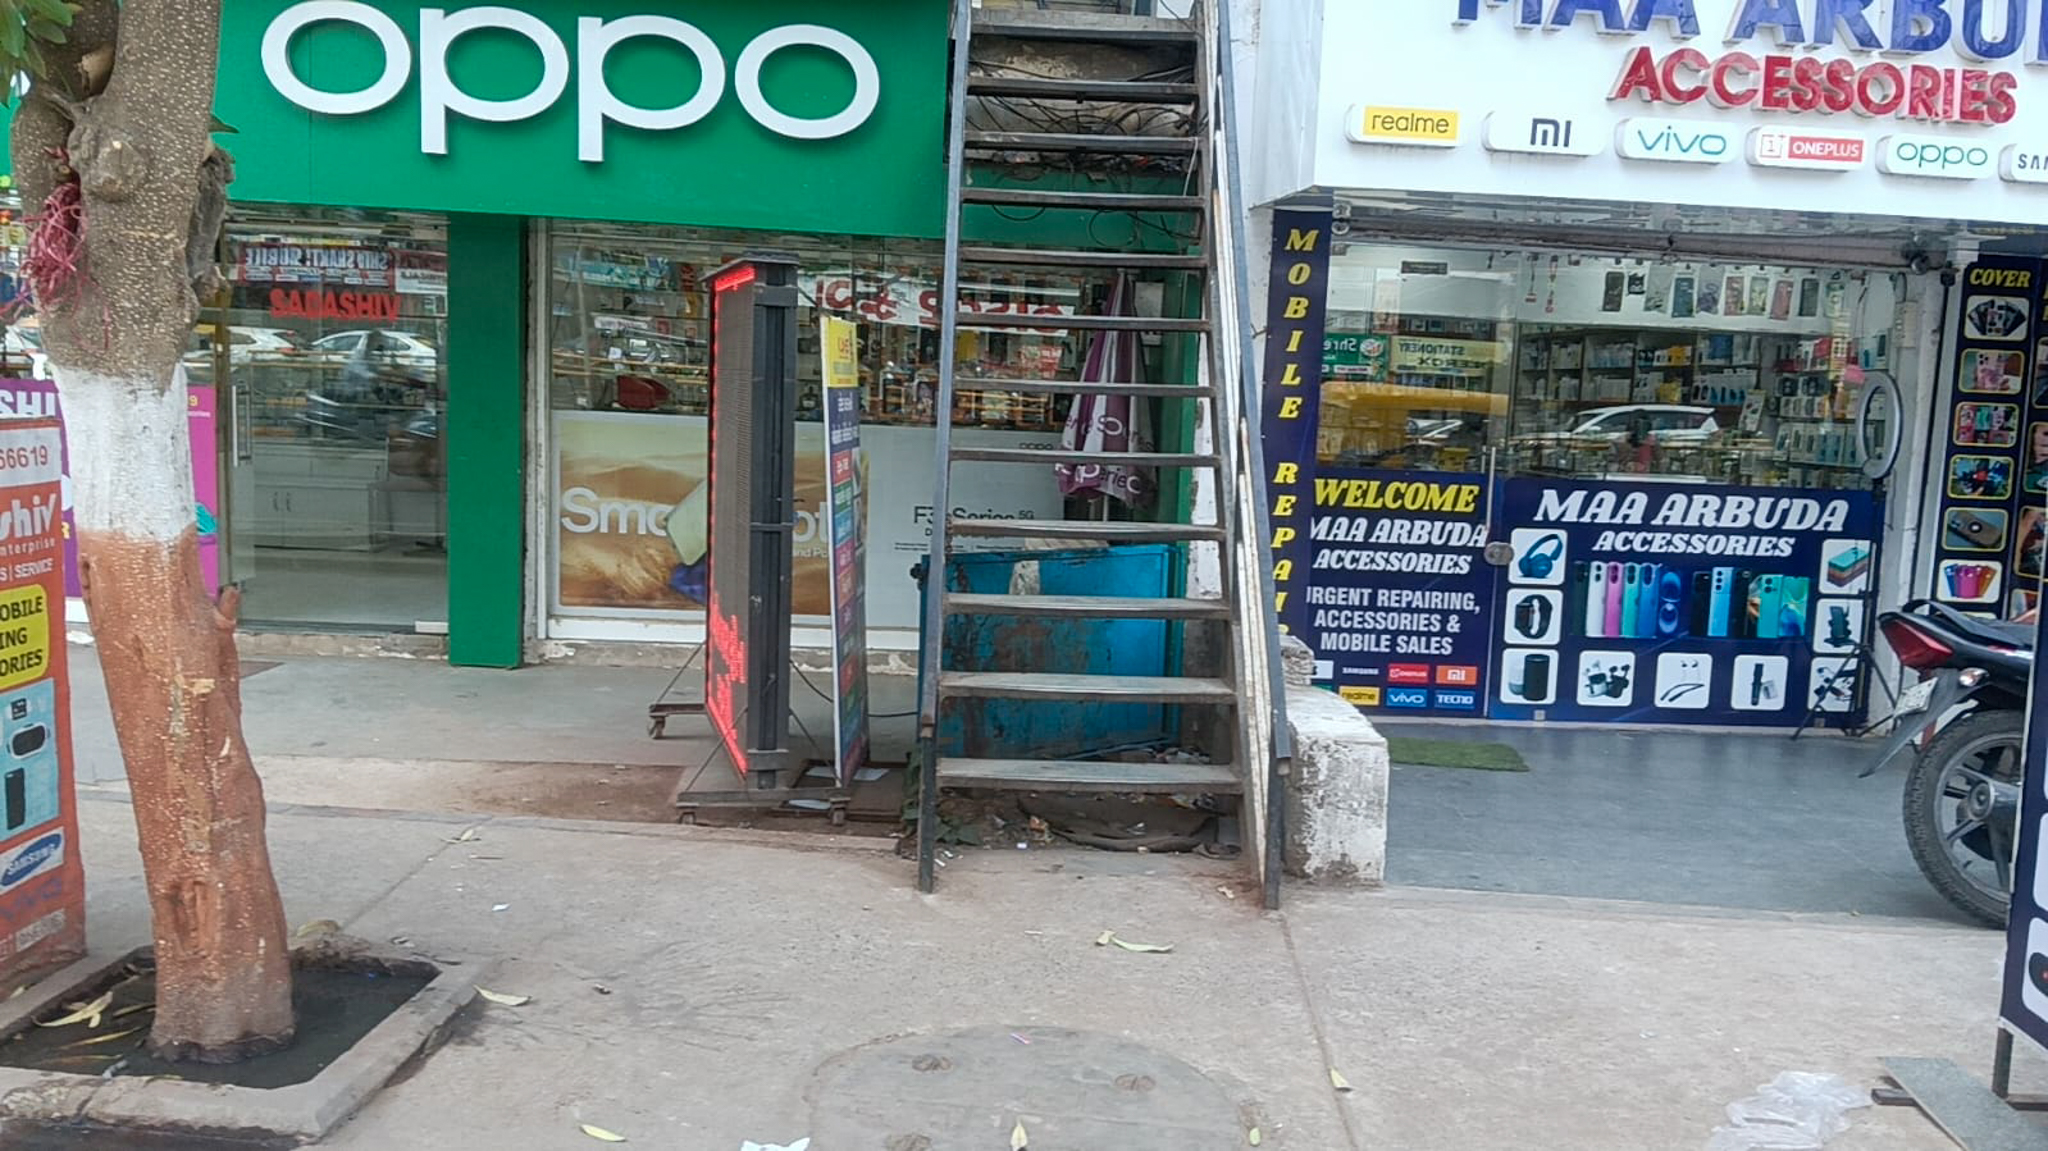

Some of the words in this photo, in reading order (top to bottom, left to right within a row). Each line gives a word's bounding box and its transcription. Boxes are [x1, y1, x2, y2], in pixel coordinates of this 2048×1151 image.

[1723, 0, 2048, 64] ARBU
[261, 0, 880, 162] oppo
[1612, 46, 2018, 124] ACCESSORIES
[1371, 112, 1450, 135] realme
[1637, 125, 1727, 156] vivo
[1792, 141, 1861, 157] ONEPLUS
[1896, 142, 1989, 169] oppo
[1969, 268, 2031, 287] COVER
[270, 287, 400, 322] SADASHIV
[1277, 229, 1319, 419] MOBILE
[1313, 478, 1480, 512] WELCOME
[1533, 488, 1651, 525] MAA
[1651, 494, 1849, 532] ARBUDA
[1369, 518, 1488, 548] ARBUDA
[1591, 531, 1796, 558] ACCESSORIES
[14, 557, 54, 578] SERVICE
[1313, 549, 1472, 574] ACCESSORIES
[1377, 588, 1480, 614] REPAIRING,
[1314, 610, 1441, 632] ACCESSORIES
[1446, 614, 1461, 633] &
[1320, 632, 1391, 653] MOBILE
[1396, 635, 1453, 656] SALES
[1390, 694, 1425, 704] vivo
